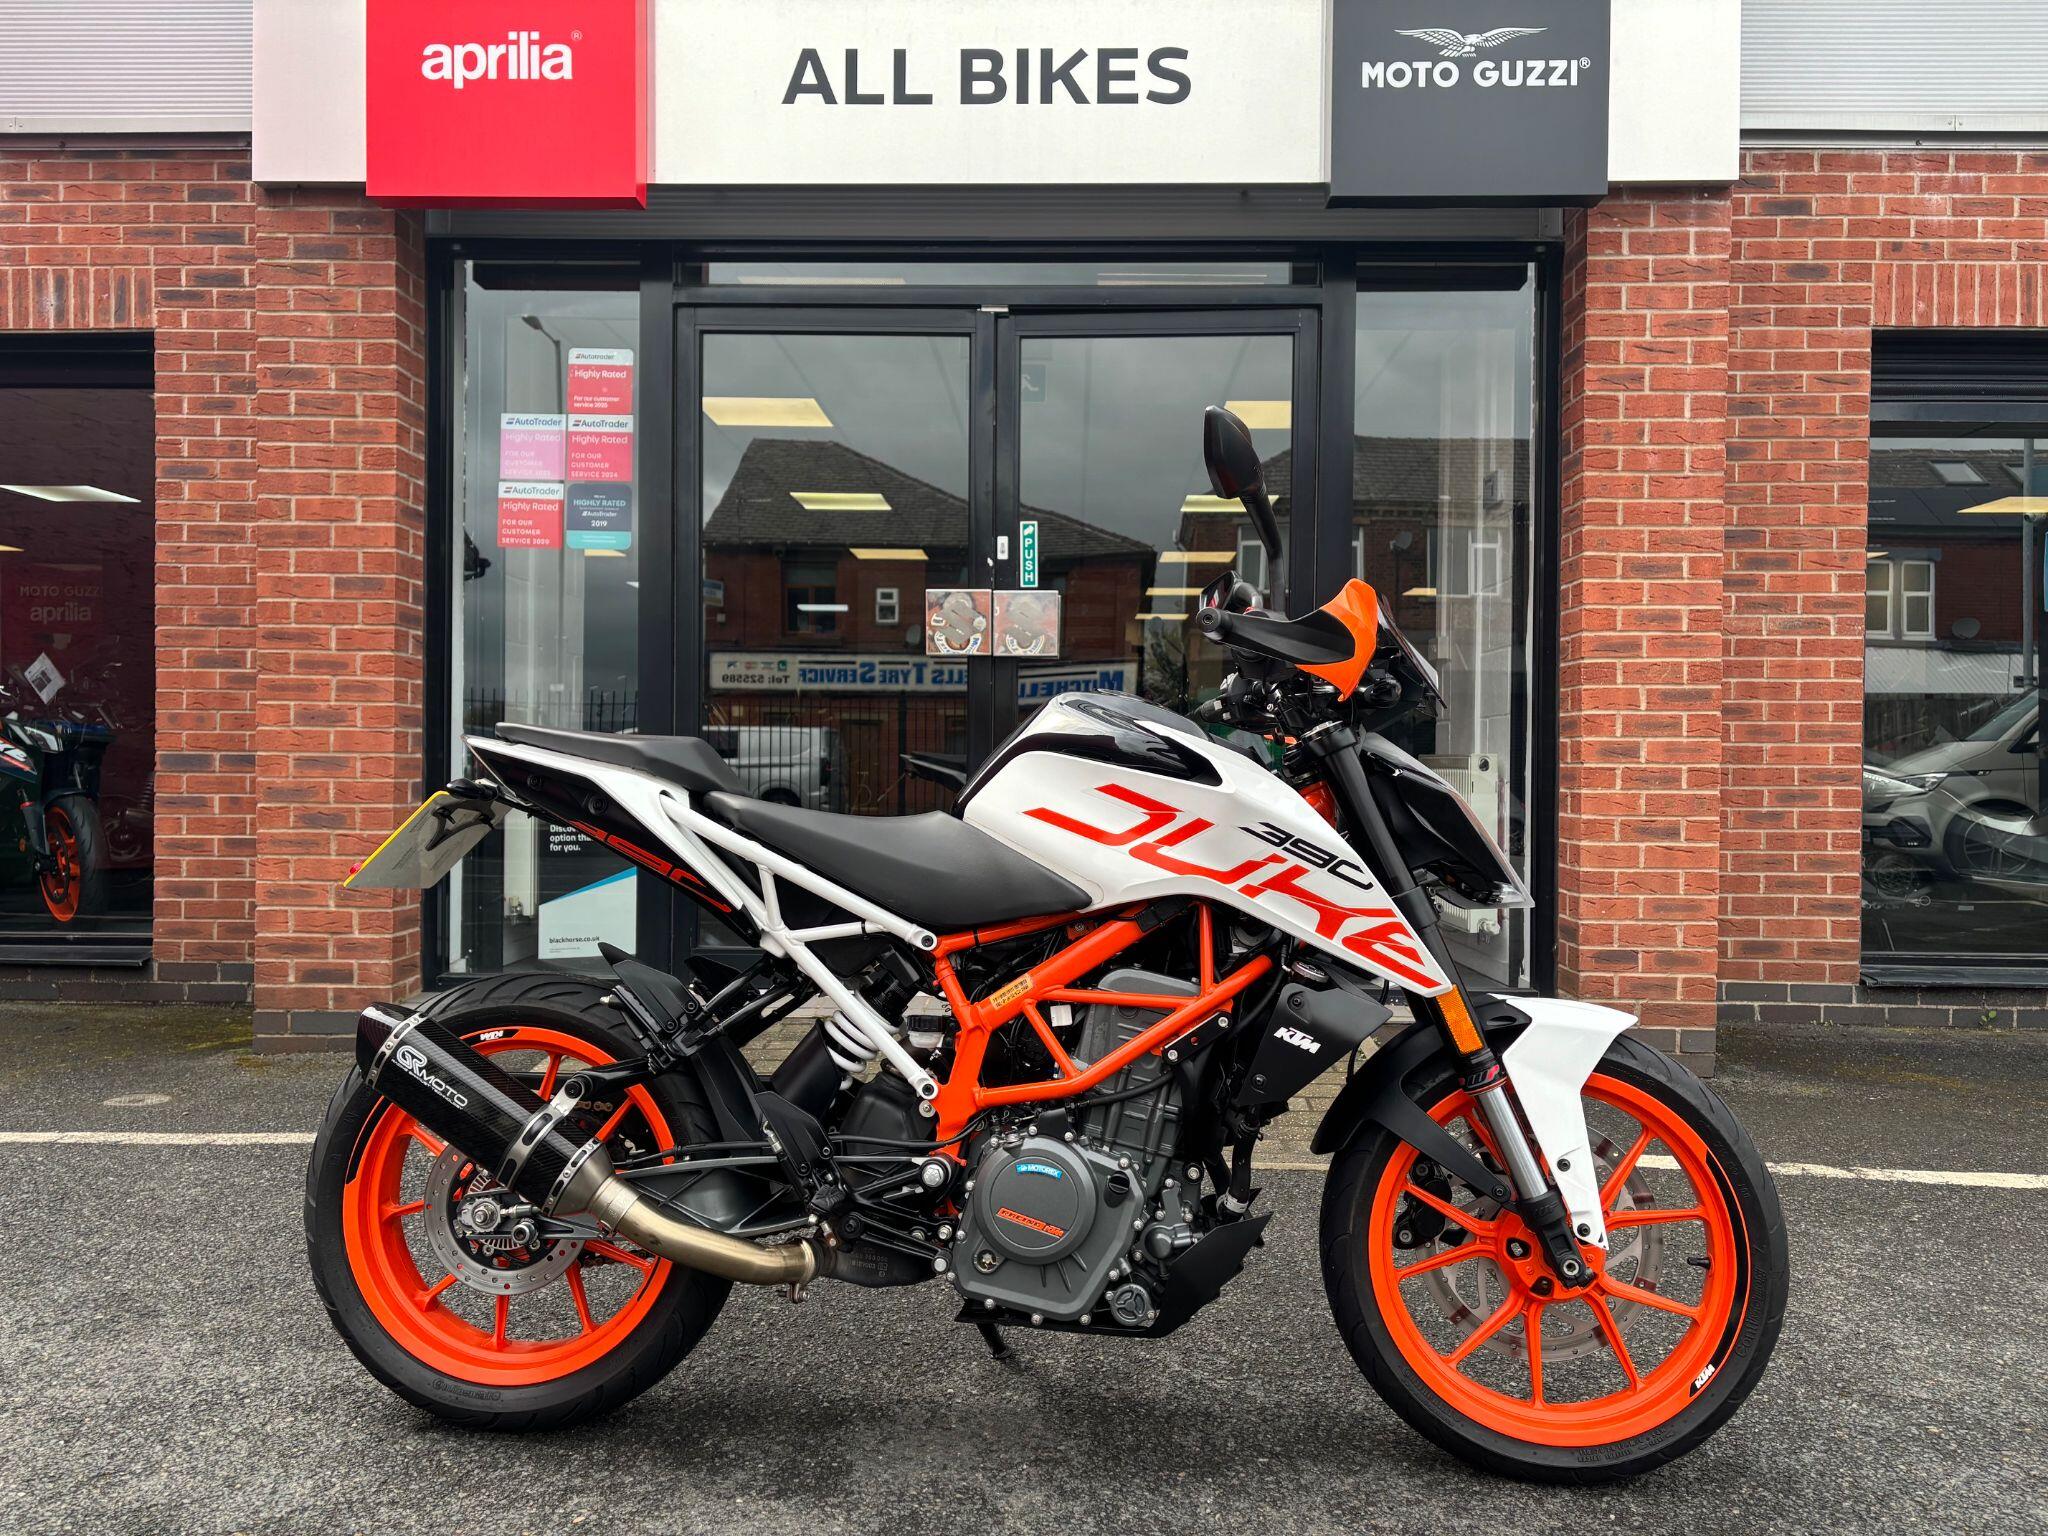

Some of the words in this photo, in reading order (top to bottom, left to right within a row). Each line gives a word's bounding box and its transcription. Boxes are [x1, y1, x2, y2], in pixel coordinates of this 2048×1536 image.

[421, 31, 573, 89] aprilia
[781, 48, 933, 105] ALL
[960, 46, 1192, 105] BIKES
[1361, 61, 1460, 88] MOTO
[575, 369, 601, 379] Highly
[601, 370, 627, 379] Rated
[514, 417, 562, 426] AutoTrader
[581, 419, 629, 429] AutoTrader
[534, 434, 561, 442] Rated
[572, 435, 599, 445] Highly
[600, 436, 628, 444] Rated
[512, 486, 560, 496] AutoTrader
[503, 501, 531, 512] Highly
[532, 503, 559, 511] Rated
[1024, 537, 1034, 582] PUSH
[20, 586, 60, 597] MOTO
[30, 602, 92, 624] aprilia
[550, 834, 577, 843] option
[550, 843, 562, 852] for
[564, 845, 581, 853] you.
[1022, 783, 1443, 989] DUKE
[549, 936, 600, 944] blackhorse.co.uk
[1273, 1026, 1321, 1054] KTM
[1027, 1164, 1058, 1178] MOTOREX
[1694, 1363, 1716, 1389] KTM
